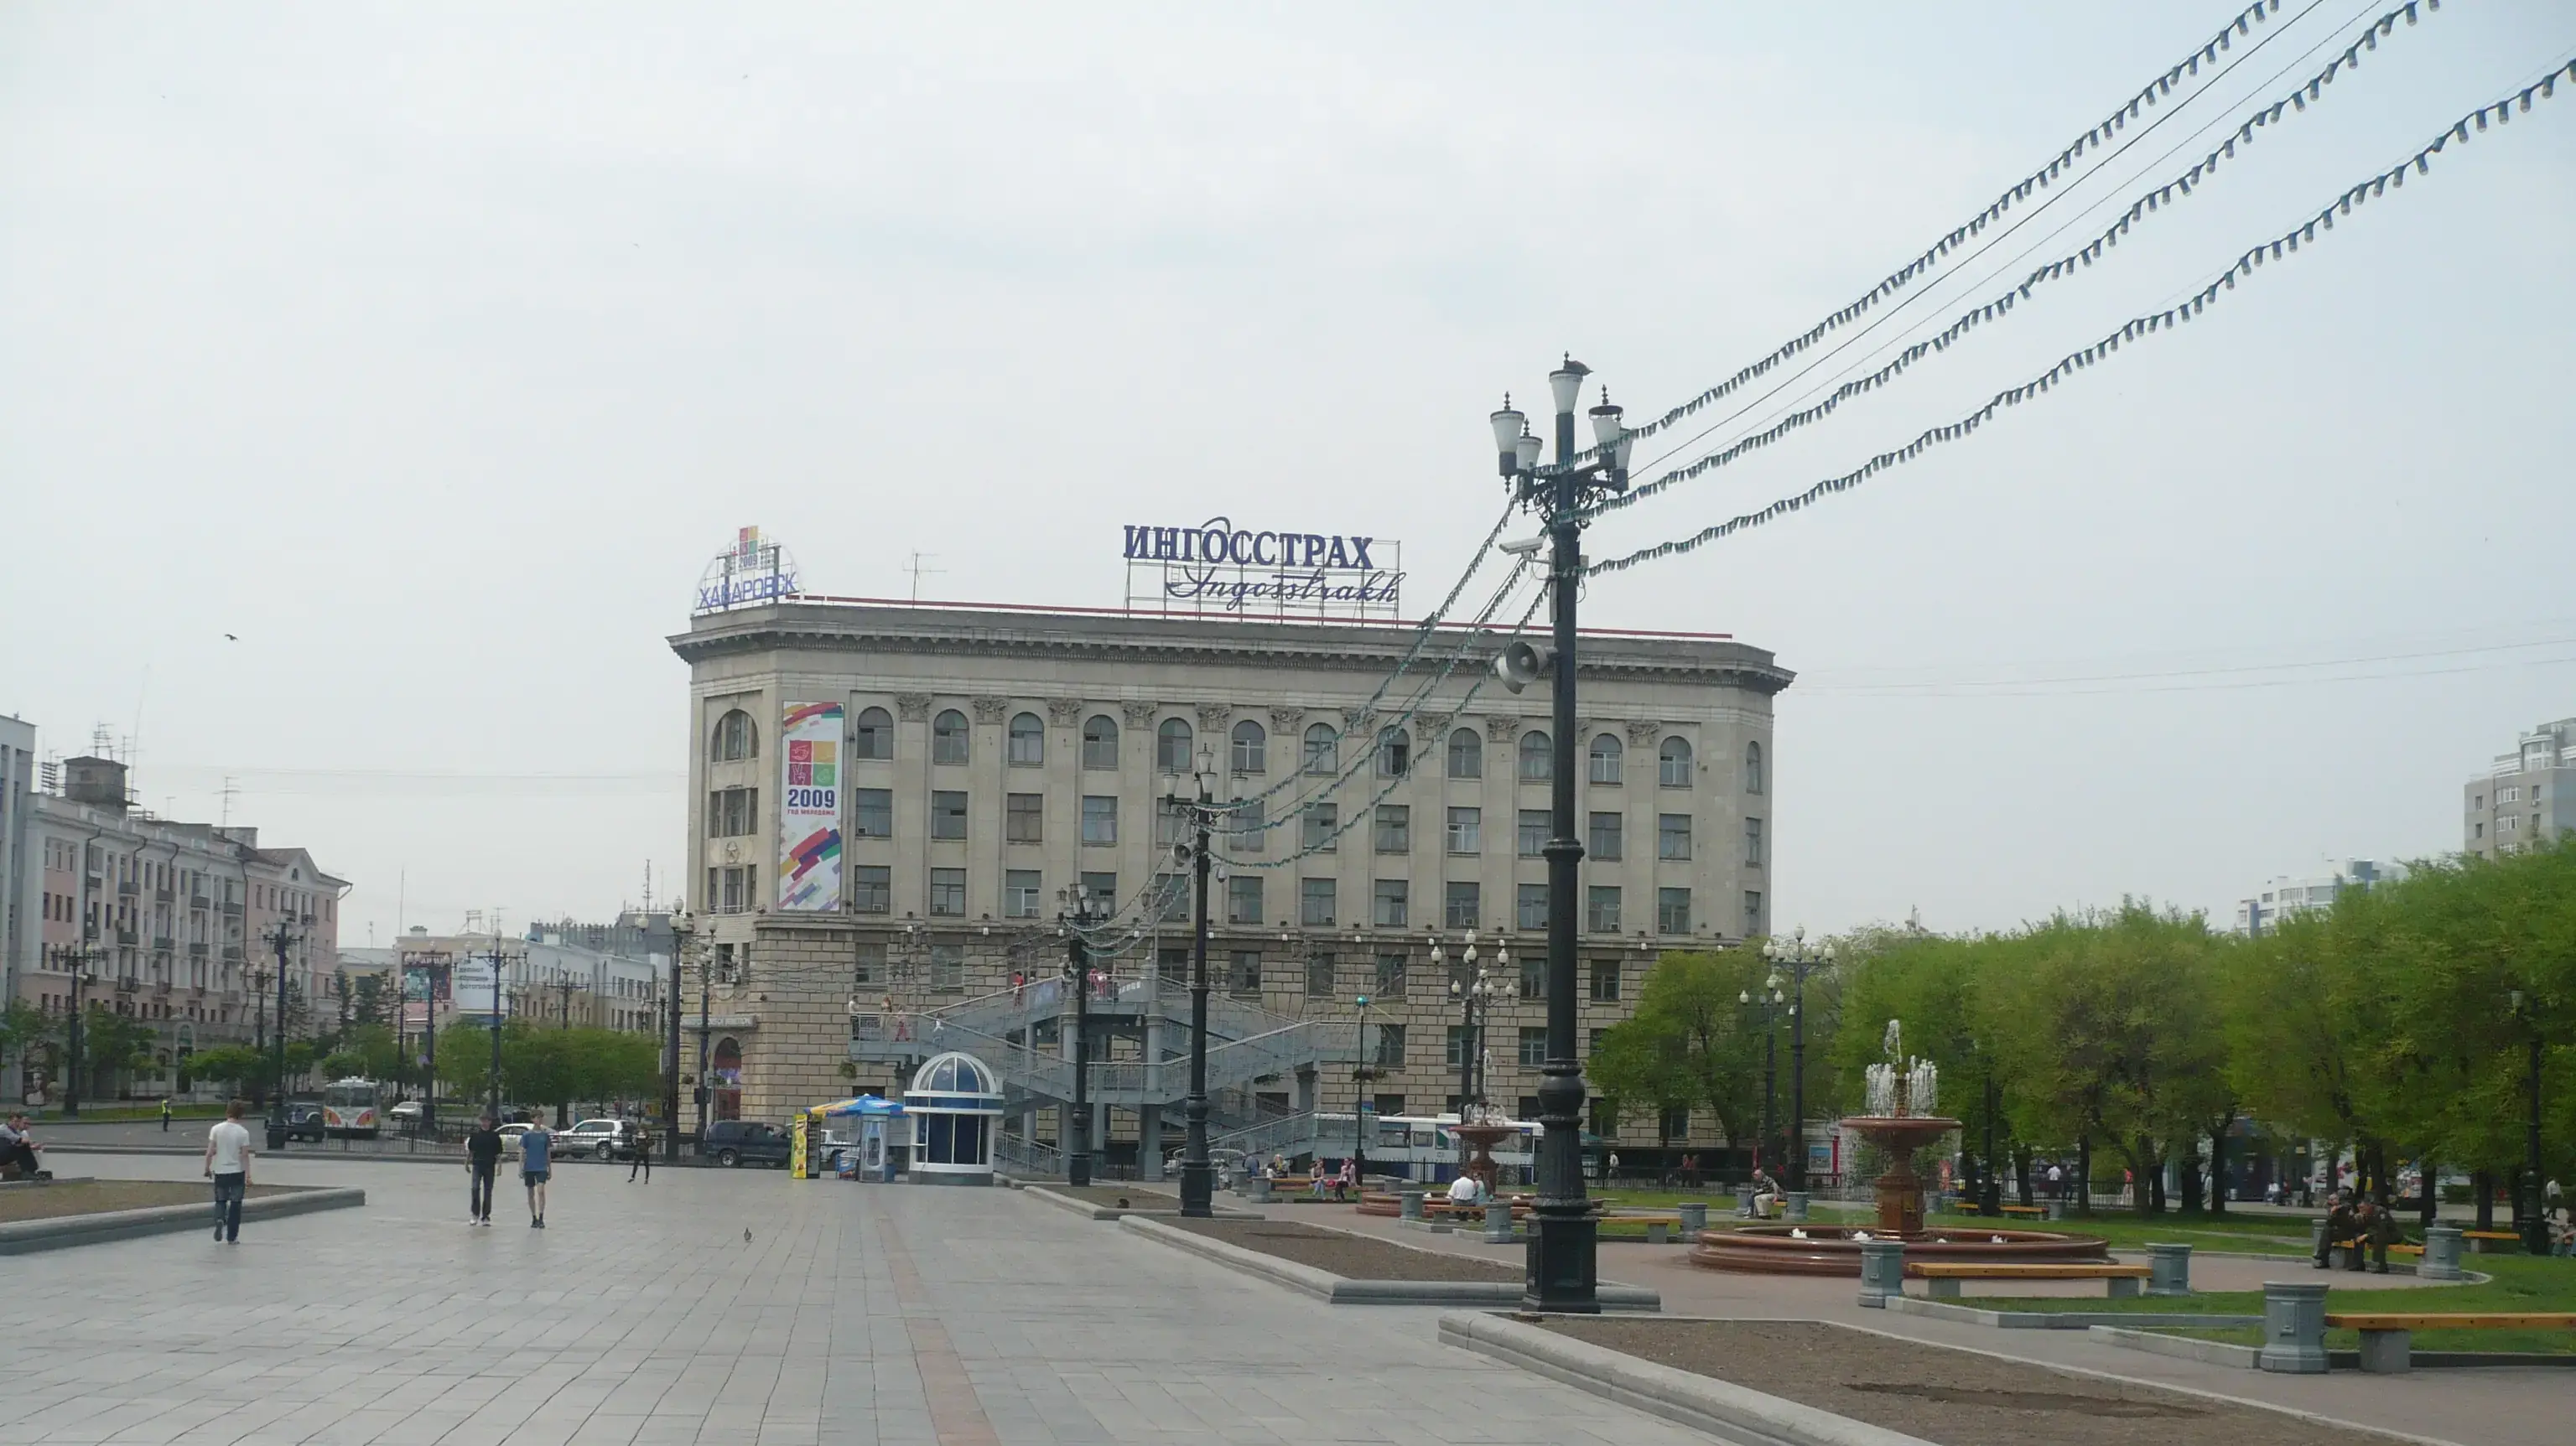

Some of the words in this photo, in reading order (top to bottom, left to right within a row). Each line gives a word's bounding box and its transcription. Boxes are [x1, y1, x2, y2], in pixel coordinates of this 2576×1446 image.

[1123, 524, 1374, 570] ИНГОССТРАХ
[699, 571, 797, 609] ХАБАРОВСК
[1165, 565, 1407, 611] Ingosstrakh
[787, 789, 835, 808] 2009
